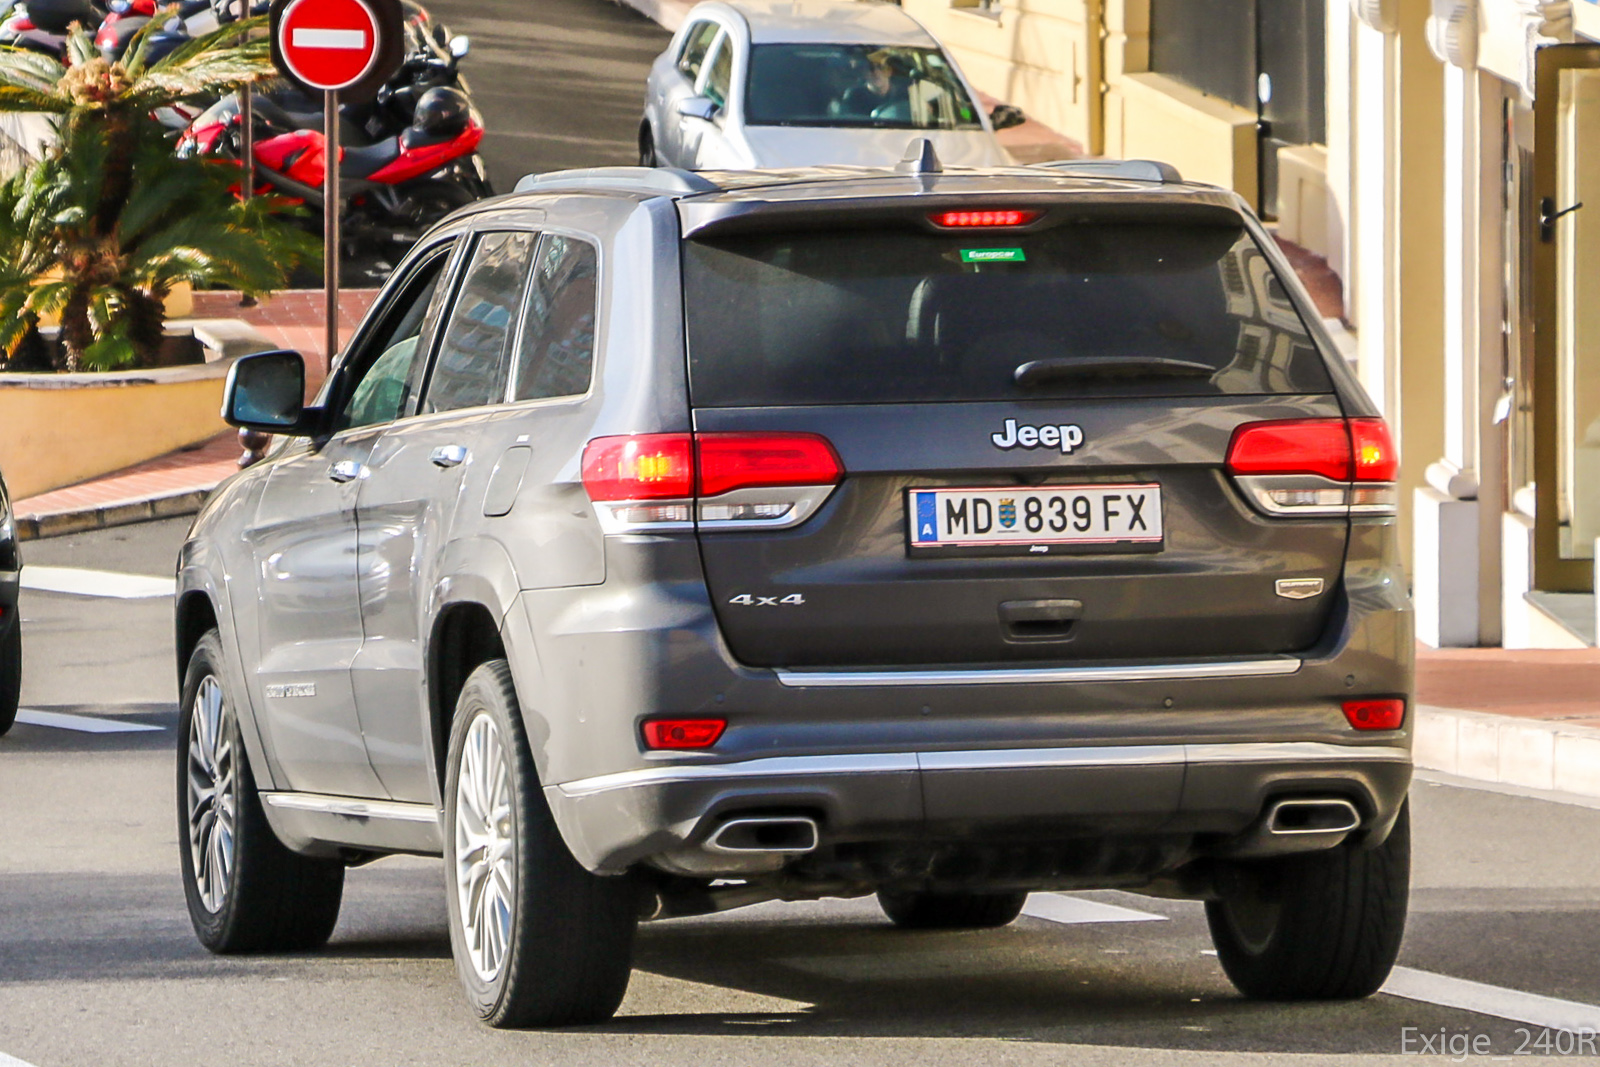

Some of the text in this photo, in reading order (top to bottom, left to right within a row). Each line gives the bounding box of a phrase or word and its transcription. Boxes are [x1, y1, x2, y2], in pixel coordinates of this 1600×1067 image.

[968, 250, 1015, 259] Europcar
[991, 418, 1083, 453] Jeep
[946, 494, 1147, 534] MD 839 FX
[922, 523, 932, 535] A
[728, 593, 806, 606] 4x4
